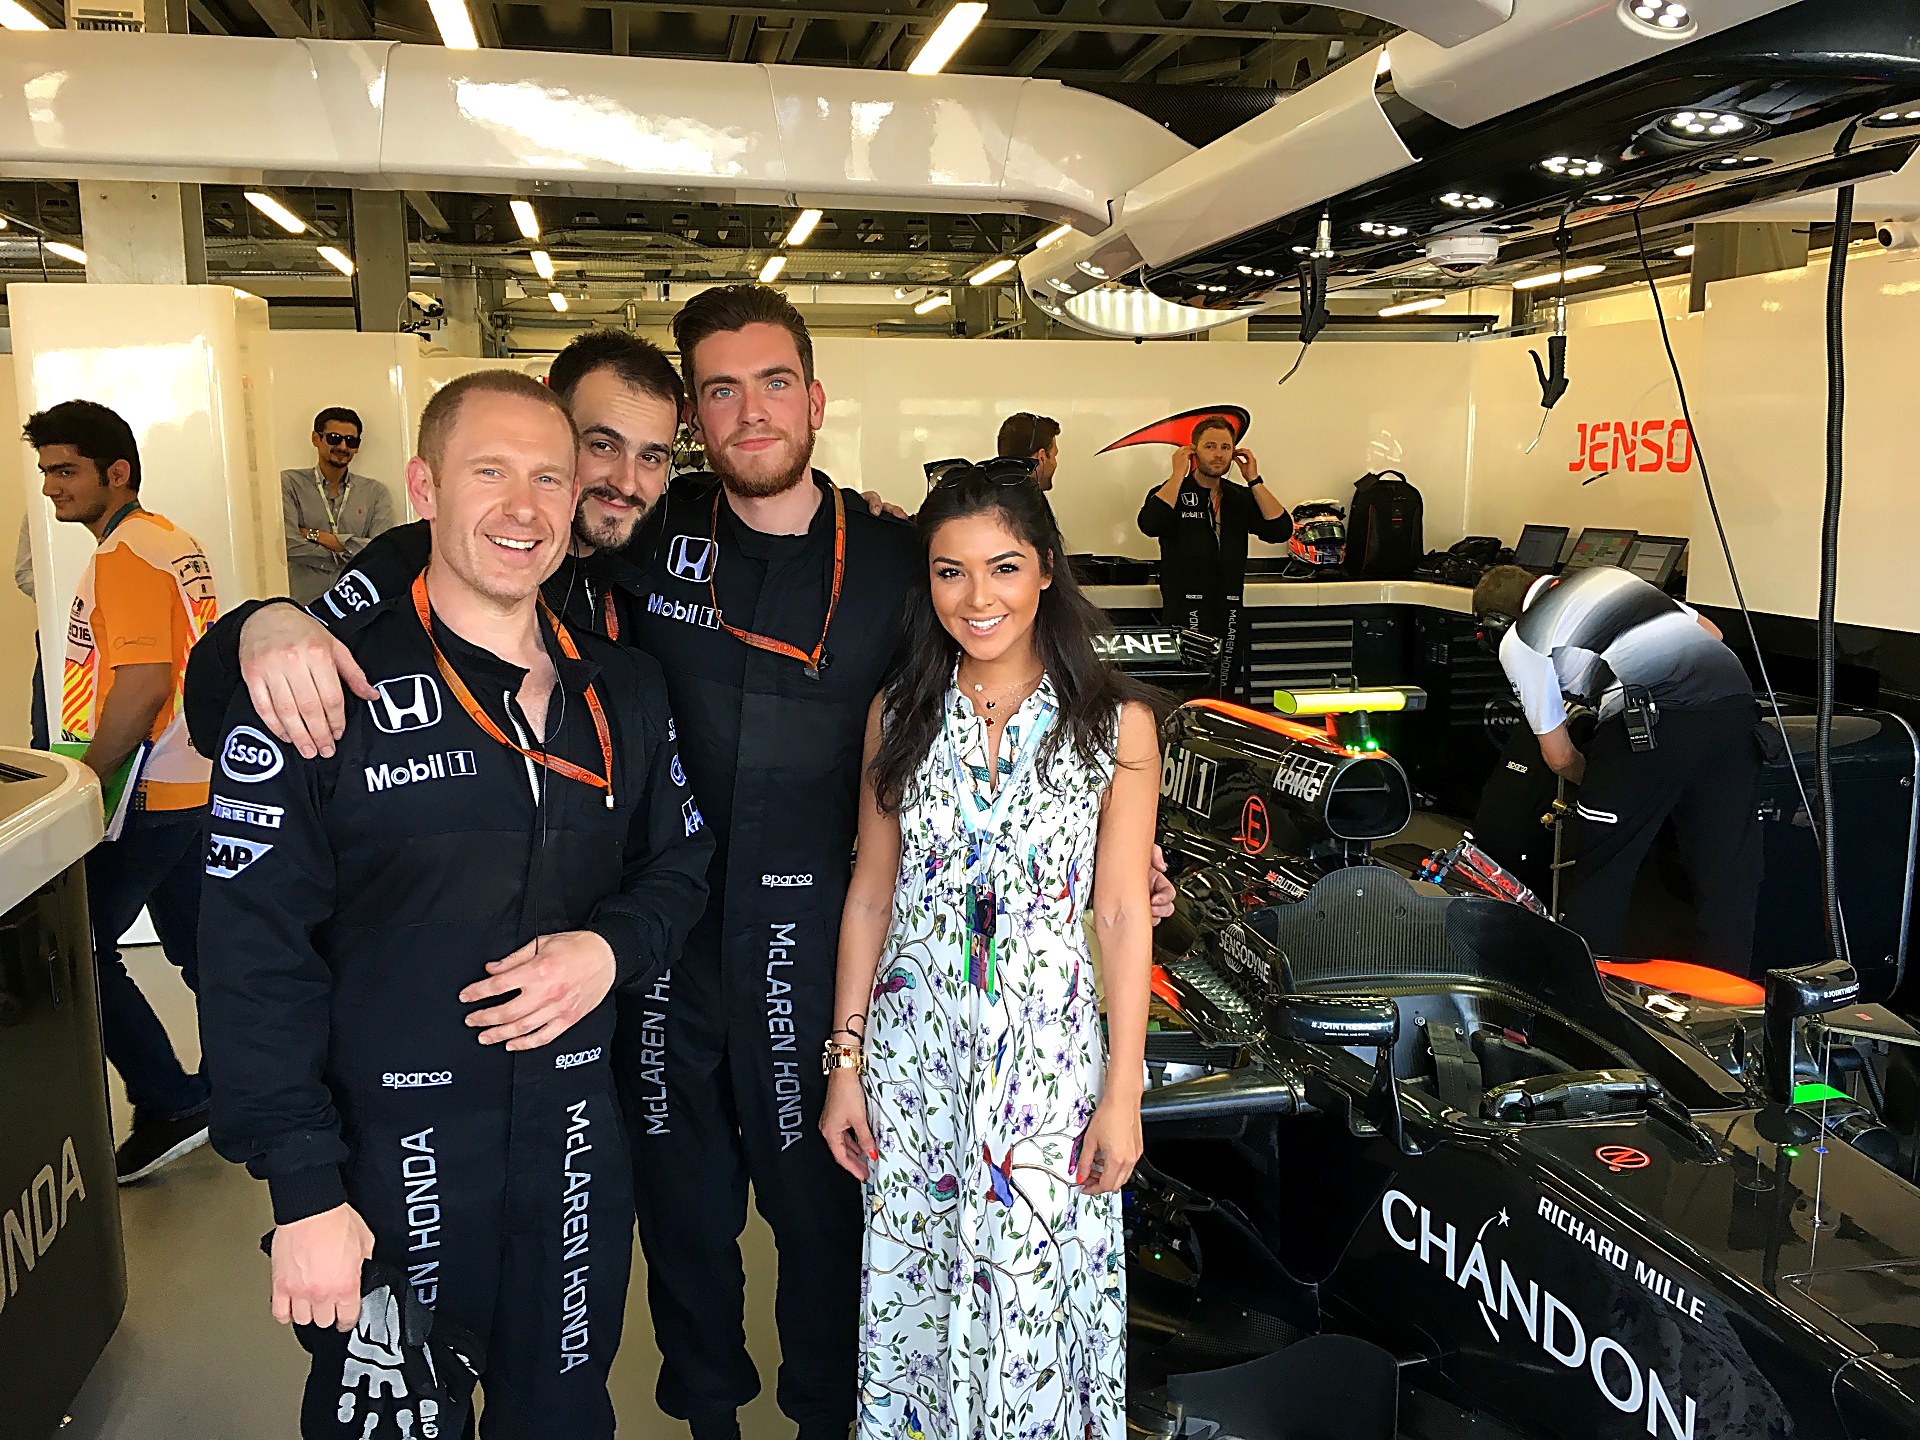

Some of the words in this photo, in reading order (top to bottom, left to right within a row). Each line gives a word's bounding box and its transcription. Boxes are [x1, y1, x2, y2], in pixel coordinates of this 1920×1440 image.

[1568, 419, 1693, 473] JENSO
[647, 593, 699, 624] Mobil
[1225, 609, 1237, 654] McLAREN
[364, 755, 446, 792] Mobil
[1159, 743, 1191, 805] bil
[1273, 767, 1321, 802] KPMG
[206, 840, 253, 871] SAP
[761, 873, 813, 887] sparco
[1219, 929, 1271, 984] SENSODYNE
[766, 922, 796, 1051] McLAREN
[381, 1071, 453, 1089] sparco
[555, 1047, 602, 1069] sparco
[641, 1011, 671, 1135] McLAREN
[773, 1062, 803, 1152] HONDA
[400, 1127, 441, 1252] HONDA
[563, 1099, 592, 1261] McLAREN
[1538, 1195, 1629, 1272] RICHARD
[1634, 1261, 1706, 1323] MILLE
[560, 1265, 592, 1375] HONDA
[1381, 1188, 1697, 1440] CHANDON
